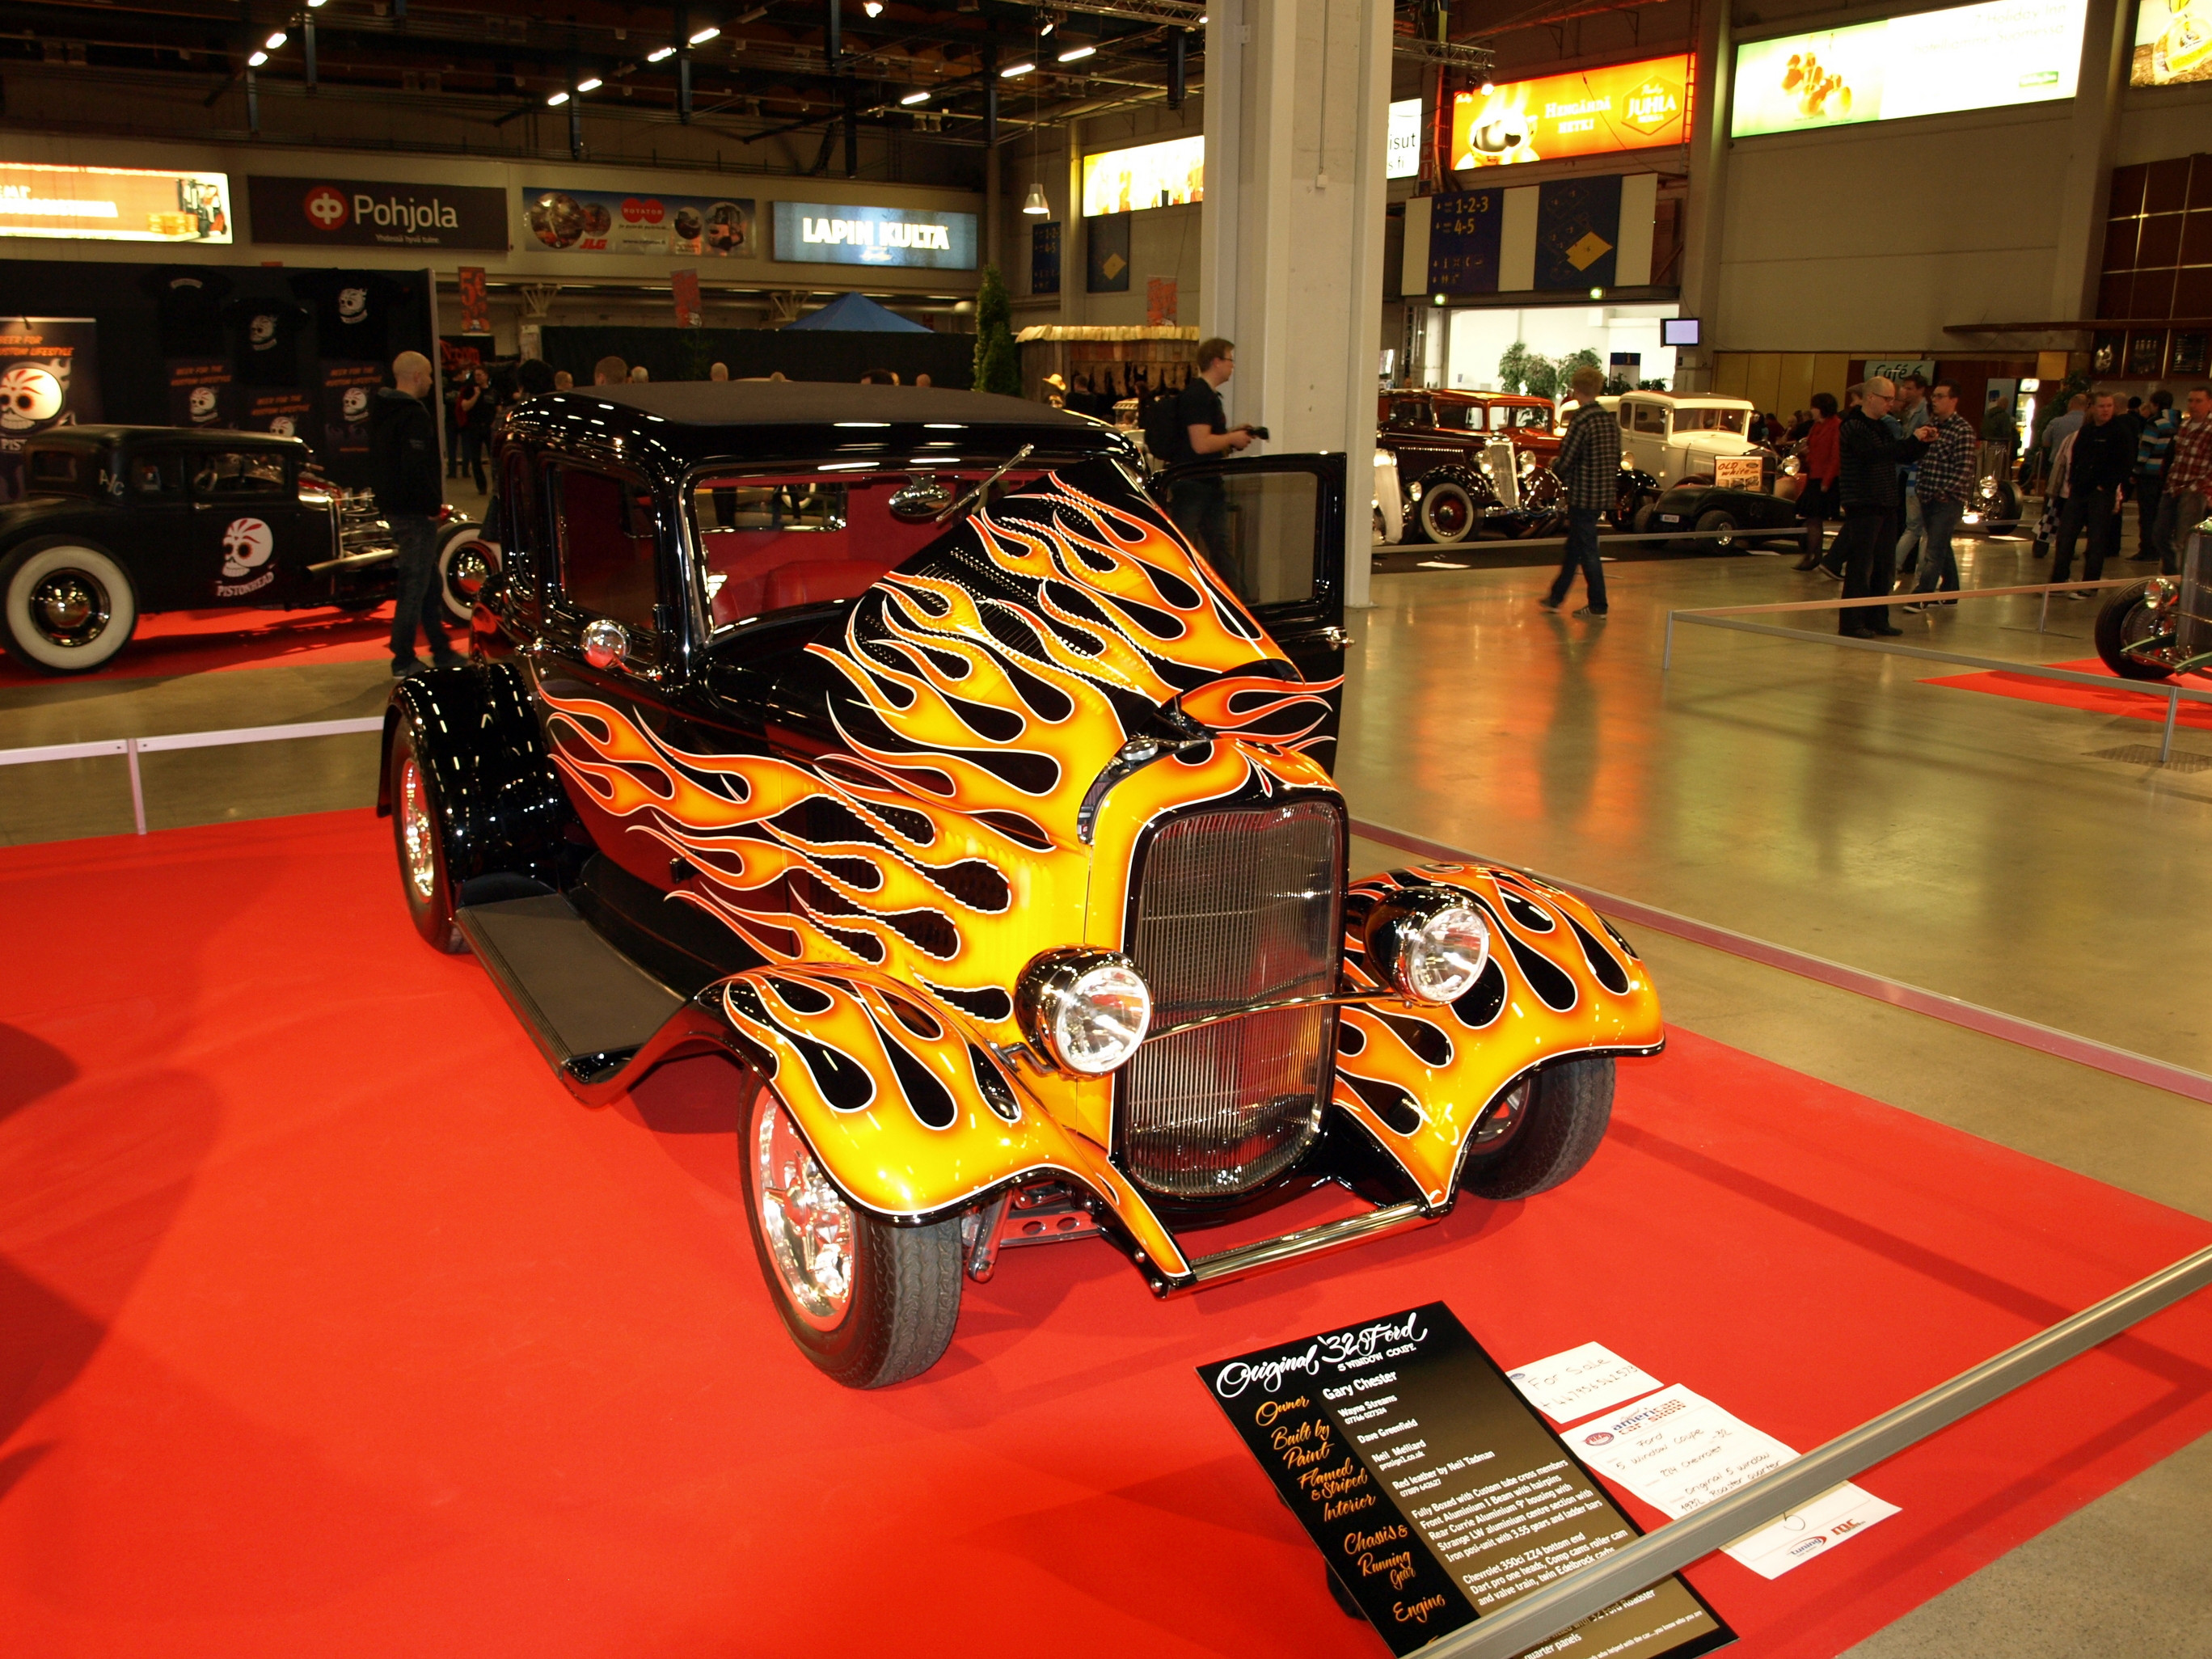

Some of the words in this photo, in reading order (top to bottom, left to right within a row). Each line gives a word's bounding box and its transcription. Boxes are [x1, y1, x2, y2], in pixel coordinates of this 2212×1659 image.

[1988, 7, 2039, 25] Holiday
[2045, 3, 2066, 15] Inn
[1625, 94, 1678, 120] JUHLA
[1558, 119, 1595, 134] HETKI
[353, 195, 459, 233] Pohjola
[1455, 196, 1489, 214] 1-2-3
[802, 217, 874, 246] LAPIN
[879, 222, 951, 250] KULTA
[1454, 218, 1475, 234] 4-5
[580, 239, 608, 251] JLG
[1718, 461, 1739, 471] OLD
[1721, 468, 1750, 477] white
[99, 468, 125, 496] A/C
[216, 571, 275, 597] PISTONHEAD
[1215, 1344, 1319, 1398] Original
[1350, 1311, 1428, 1357] Ford
[1336, 1362, 1346, 1372] 5
[1344, 1351, 1383, 1369] WINDOW
[1385, 1342, 1416, 1357] COUPE
[1322, 1383, 1353, 1400] Gary
[1353, 1370, 1397, 1391] Chester
[1528, 1374, 1559, 1390] For
[1565, 1358, 1611, 1375] Sale
[1255, 1395, 1310, 1426] Owner
[1336, 1404, 1366, 1417] Wayne
[1363, 1394, 1398, 1409] Streams
[1612, 1399, 1686, 1431] american
[1618, 1423, 1642, 1435] car
[1648, 1404, 1686, 1422] show
[1270, 1420, 1311, 1450] Built
[1314, 1418, 1330, 1441] by
[1356, 1432, 1379, 1444] Dave
[1377, 1417, 1418, 1437] Greenfield
[1636, 1432, 1664, 1446] Ford
[1281, 1441, 1334, 1469] Paint
[1370, 1450, 1391, 1463] Neil
[1391, 1438, 1426, 1456] Melliard
[1296, 1456, 1361, 1489] Flamed
[1391, 1477, 1410, 1489] Red
[1408, 1470, 1437, 1484] leather
[1435, 1466, 1448, 1475] by
[1446, 1458, 1465, 1471] Neil
[1462, 1450, 1495, 1465] Tadman
[1616, 1462, 1626, 1471] 5
[1685, 1472, 1724, 1495] Original
[1724, 1467, 1734, 1476] 5
[1311, 1488, 1321, 1501] &
[1320, 1467, 1368, 1499] Striped
[1411, 1506, 1433, 1518] Fully
[1430, 1496, 1457, 1512] Boxed
[1455, 1492, 1474, 1503] with
[1472, 1483, 1501, 1496] Custom
[1500, 1477, 1518, 1488] tube
[1517, 1470, 1537, 1481] cross
[1535, 1459, 1568, 1475] members
[1323, 1493, 1376, 1522] Interior
[1419, 1516, 1444, 1529] Front
[1442, 1501, 1486, 1522] Aluminium
[1489, 1492, 1514, 1505] Beam
[1513, 1484, 1532, 1496] with
[1529, 1475, 1562, 1490] hairpins
[1428, 1528, 1449, 1540] Rear
[1448, 1518, 1475, 1533] Currie
[1475, 1504, 1518, 1524] Aluminium
[1524, 1490, 1556, 1505] housing
[1554, 1483, 1572, 1494] with
[1437, 1534, 1471, 1551] Strange
[1468, 1527, 1484, 1539] LW
[1485, 1514, 1526, 1534] aluminium
[1525, 1505, 1551, 1518] centre
[1549, 1496, 1577, 1510] section
[1575, 1488, 1594, 1500] with
[1445, 1551, 1464, 1562] Iron
[1463, 1538, 1496, 1557] posi-unit
[1494, 1532, 1513, 1543] with
[1509, 1524, 1530, 1538] 3.55
[1529, 1518, 1551, 1532] gears
[1549, 1512, 1564, 1523] and
[1562, 1505, 1586, 1518] ladder
[1584, 1499, 1602, 1510] bars
[1344, 1525, 1397, 1555] Chassis
[1397, 1524, 1408, 1538] &
[1791, 1538, 1822, 1556] tuning
[1357, 1551, 1412, 1577] Running
[1462, 1564, 1502, 1584] Chevrolet
[1499, 1554, 1526, 1570] 350ci
[1522, 1547, 1543, 1561] ZZ4
[1540, 1539, 1571, 1554] bottom
[1569, 1531, 1585, 1543] end
[1469, 1581, 1492, 1594] Dart
[1490, 1577, 1505, 1588] pro
[1505, 1570, 1521, 1581] one
[1518, 1561, 1547, 1575] heads,
[1544, 1551, 1569, 1565] Comp
[1568, 1543, 1590, 1556] cams
[1589, 1535, 1610, 1548] roller
[1610, 1529, 1627, 1540] cam
[1389, 1568, 1415, 1589] Gear
[1477, 1593, 1494, 1606] and
[1493, 1586, 1516, 1599] valve
[1514, 1578, 1539, 1590] train,
[1554, 1554, 1595, 1575] Edelbrock
[1392, 1594, 1446, 1623] Engine
[1555, 1632, 1582, 1651] panels
